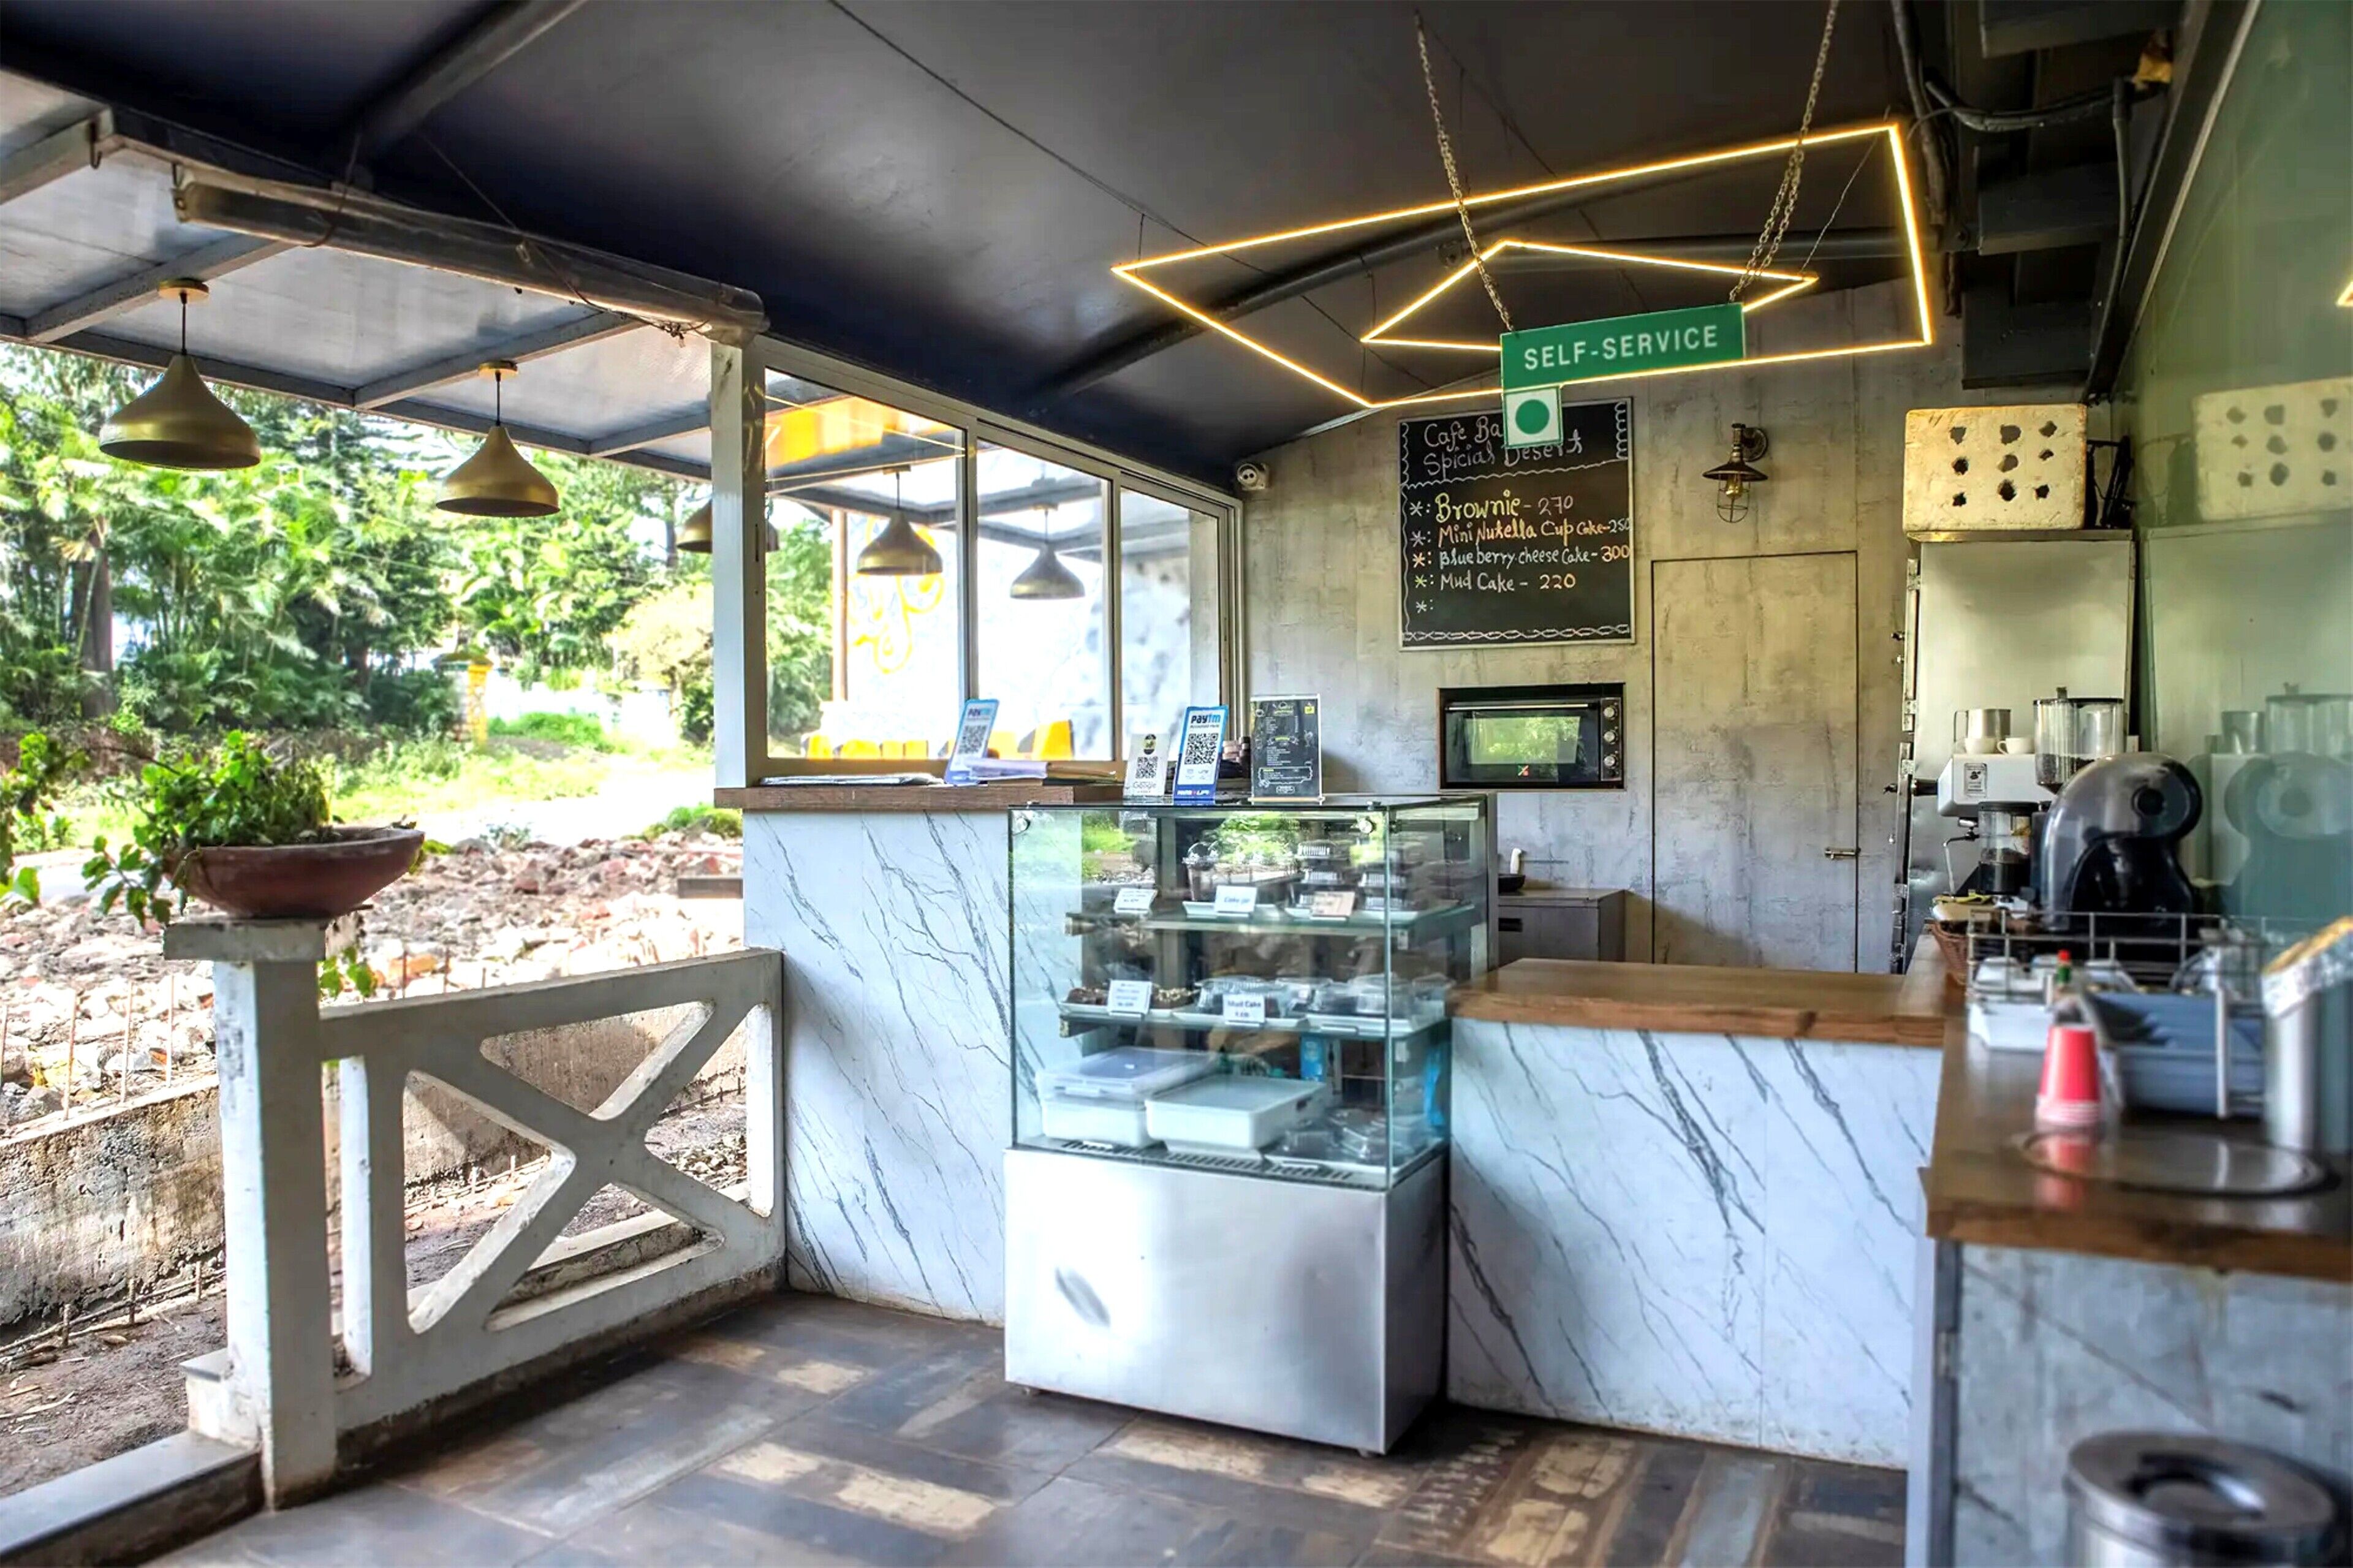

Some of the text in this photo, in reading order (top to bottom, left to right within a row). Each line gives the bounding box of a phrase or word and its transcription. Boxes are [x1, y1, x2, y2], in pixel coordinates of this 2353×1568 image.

[1524, 325, 1718, 371] SELF-SERVICE
[1423, 420, 1468, 452] Cafe
[1537, 495, 1574, 515] 270
[1438, 521, 1473, 548] Mini
[1475, 517, 1537, 546] Nutella
[1540, 518, 1574, 547] Cup
[1561, 546, 1591, 565] Cake
[1601, 545, 1630, 562] 300
[1440, 569, 1472, 591] Mud
[1477, 571, 1515, 593] Cake
[1539, 573, 1575, 589] 220
